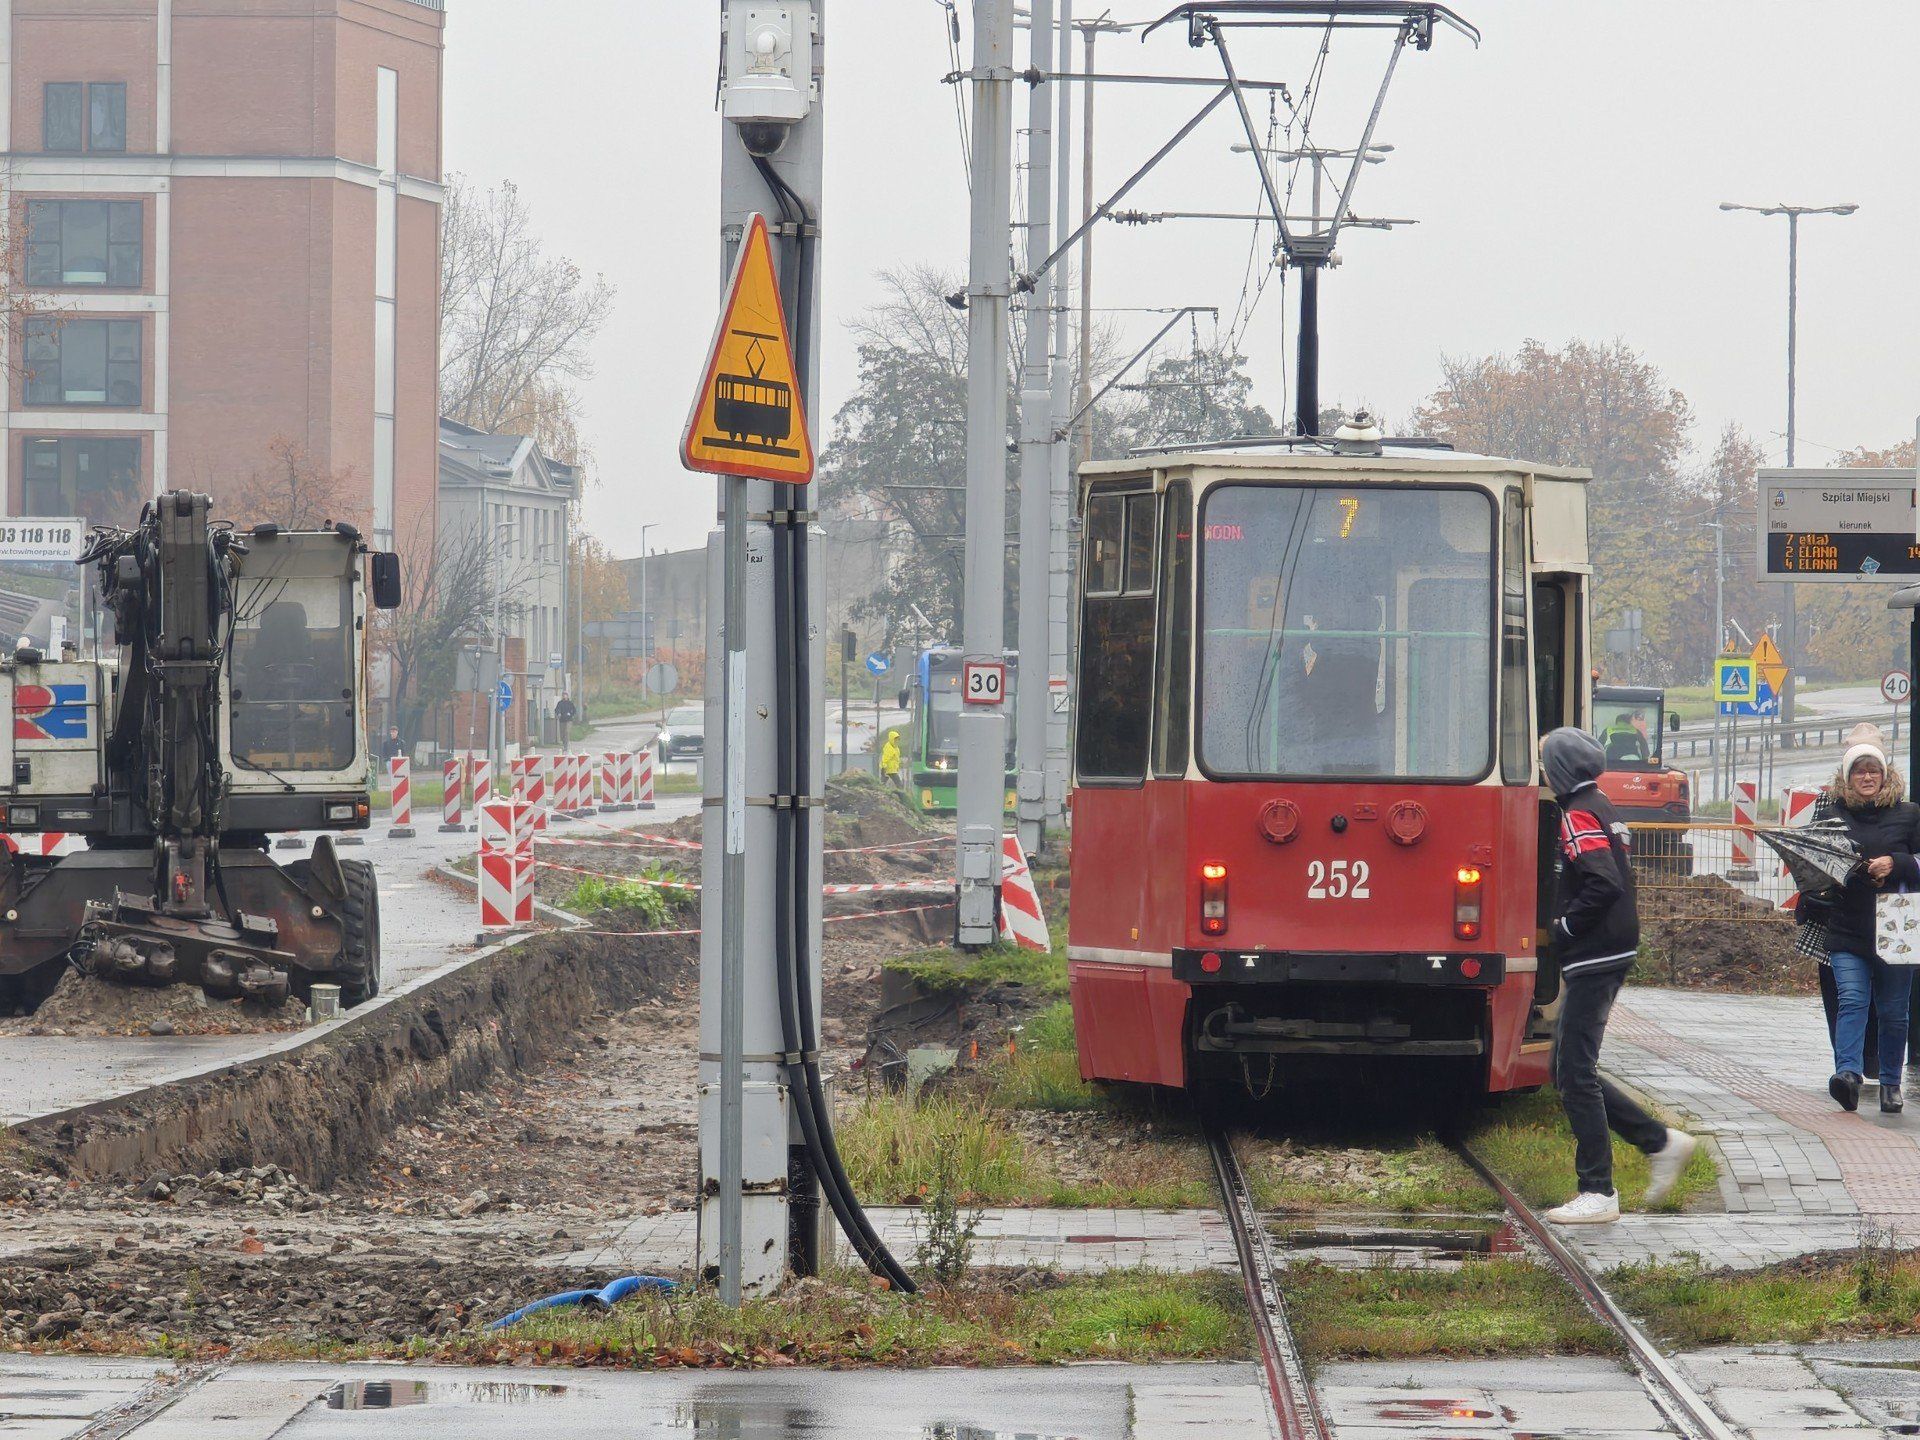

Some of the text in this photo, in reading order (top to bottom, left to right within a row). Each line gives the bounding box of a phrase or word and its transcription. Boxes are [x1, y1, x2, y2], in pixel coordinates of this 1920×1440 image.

[1822, 492, 1890, 504] Szpital Miejski
[1339, 498, 1359, 539] 7
[1771, 520, 1788, 529] linia
[1839, 520, 1872, 530] kierunek
[20, 527, 44, 543] 118
[48, 528, 72, 544] 118
[1785, 534, 1794, 545] 7
[1785, 546, 1794, 558] 2
[1798, 546, 1838, 558] ELANA
[1798, 558, 1838, 570] ELANA
[970, 673, 999, 693] 30
[1885, 678, 1908, 694] 40
[1306, 859, 1371, 899] 252
